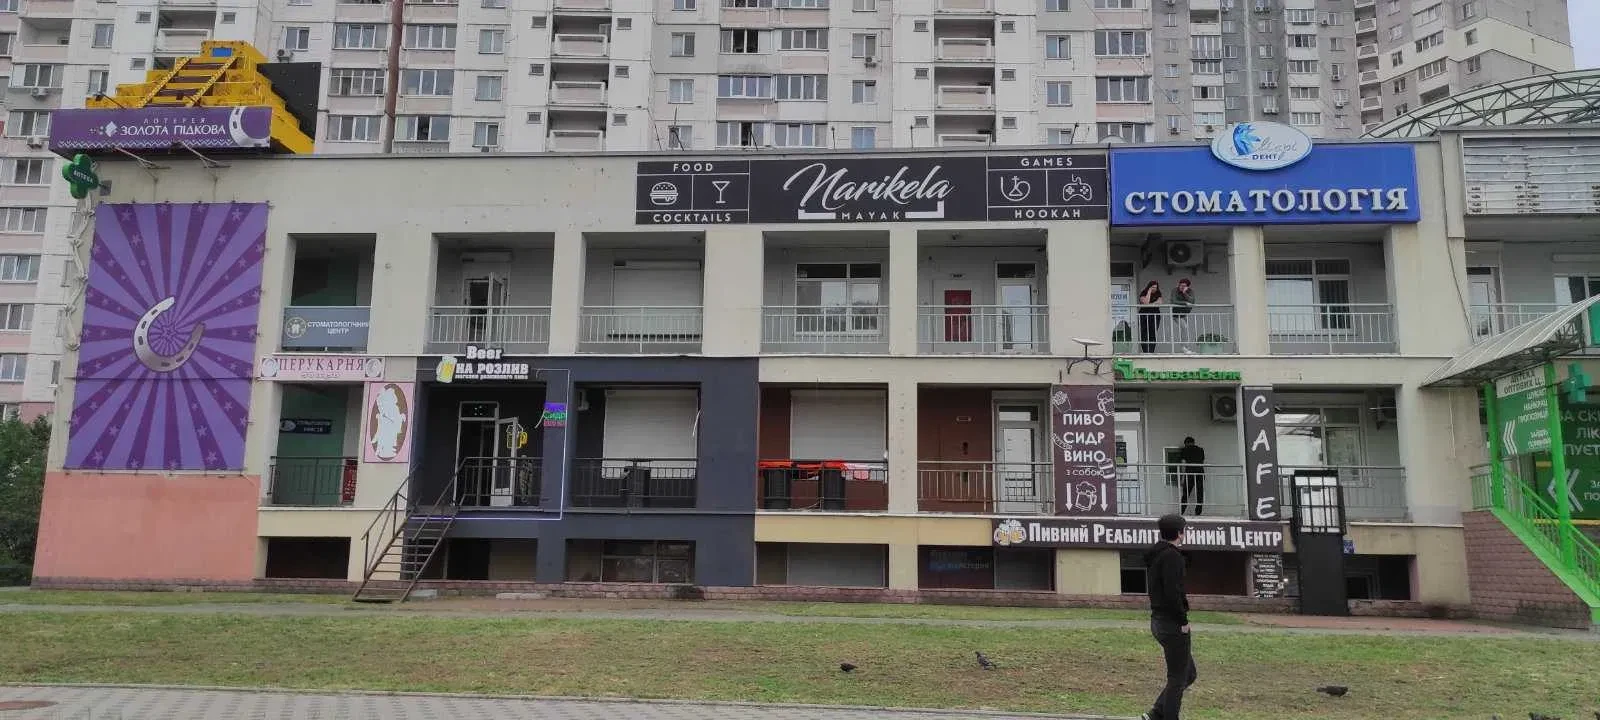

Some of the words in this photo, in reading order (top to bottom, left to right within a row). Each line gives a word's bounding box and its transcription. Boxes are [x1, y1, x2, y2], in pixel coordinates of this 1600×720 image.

[120, 125, 169, 136] ЗОЛОТА
[173, 124, 226, 136] ПІДКОВА
[673, 163, 714, 173] FOOD
[1020, 157, 1074, 167] GAMES
[783, 162, 956, 211] Narikela
[1124, 187, 1409, 214] СТОМАТОЛОГІЯ
[652, 213, 732, 223] COCKTAILS
[841, 210, 901, 220] MAYAK
[1014, 208, 1081, 219] HOOKAH
[327, 327, 350, 335] ЦЕНТР
[466, 345, 503, 360] Beer
[279, 357, 365, 371] ПЕРУКАРНЯ
[455, 363, 473, 374] НА
[477, 363, 529, 374] РОЗЛИВ
[1063, 413, 1105, 426] ПИВО
[1063, 431, 1105, 446] СИДР
[1064, 450, 1106, 463] ВИНО
[1250, 394, 1277, 519] CAFE
[1029, 522, 1088, 543] ПИВНИЙ
[1230, 526, 1282, 549] ЦЕНТР
